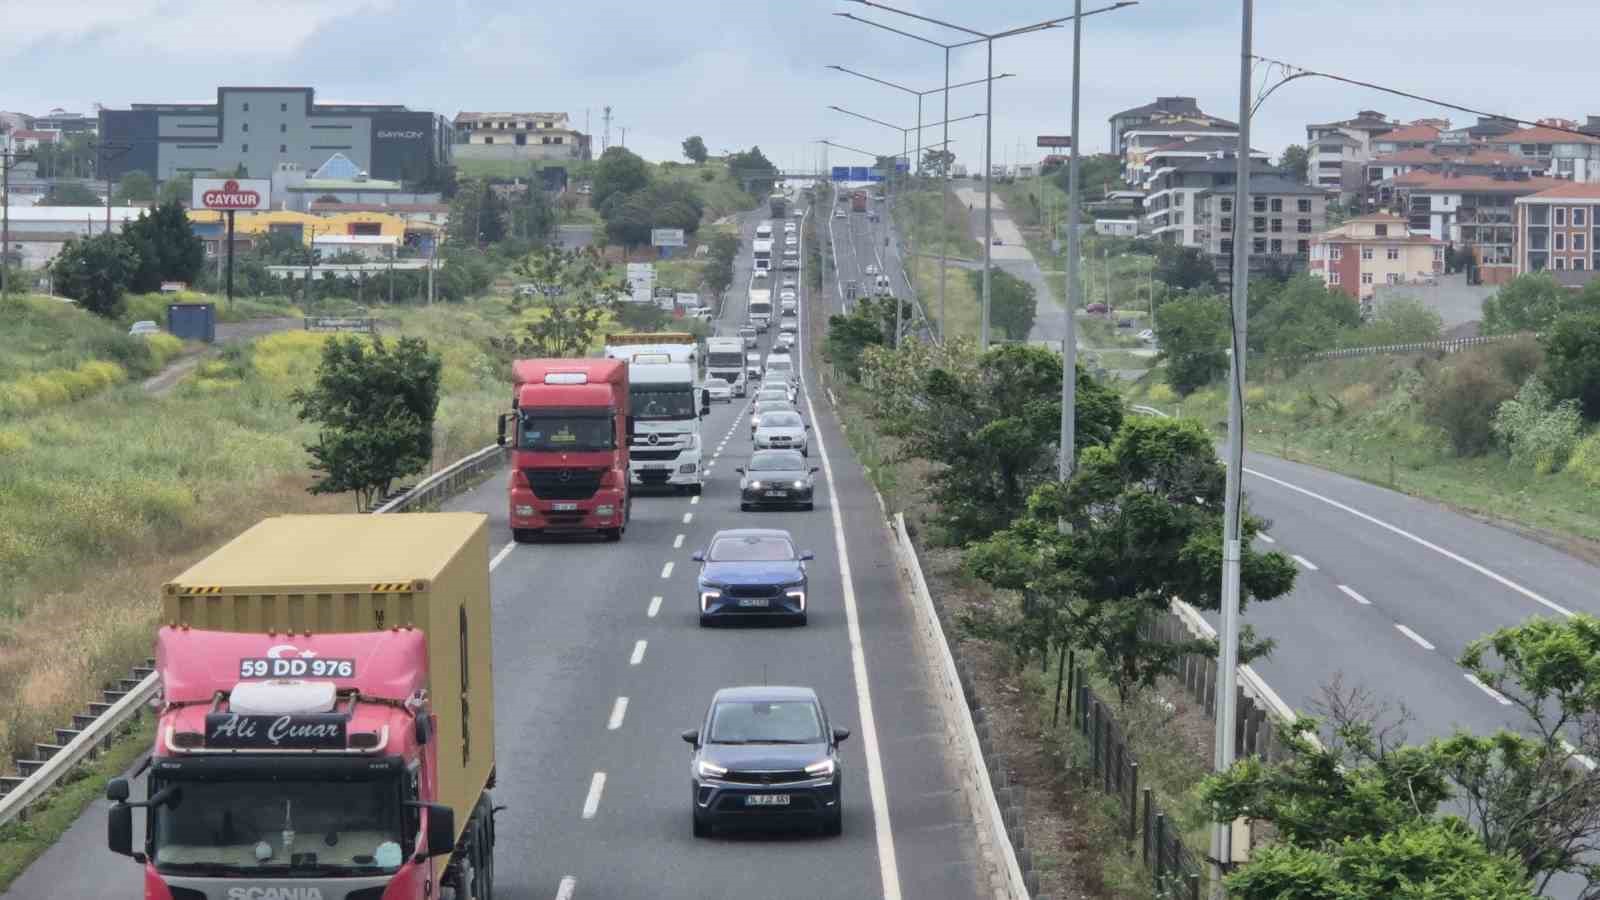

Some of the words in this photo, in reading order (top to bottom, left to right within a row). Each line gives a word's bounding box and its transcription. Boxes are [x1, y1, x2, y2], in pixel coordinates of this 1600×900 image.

[241, 660, 268, 677] 59
[273, 660, 307, 676] DD
[312, 660, 352, 676] 976
[211, 712, 256, 738] Ali
[228, 887, 321, 900] SCANIA
